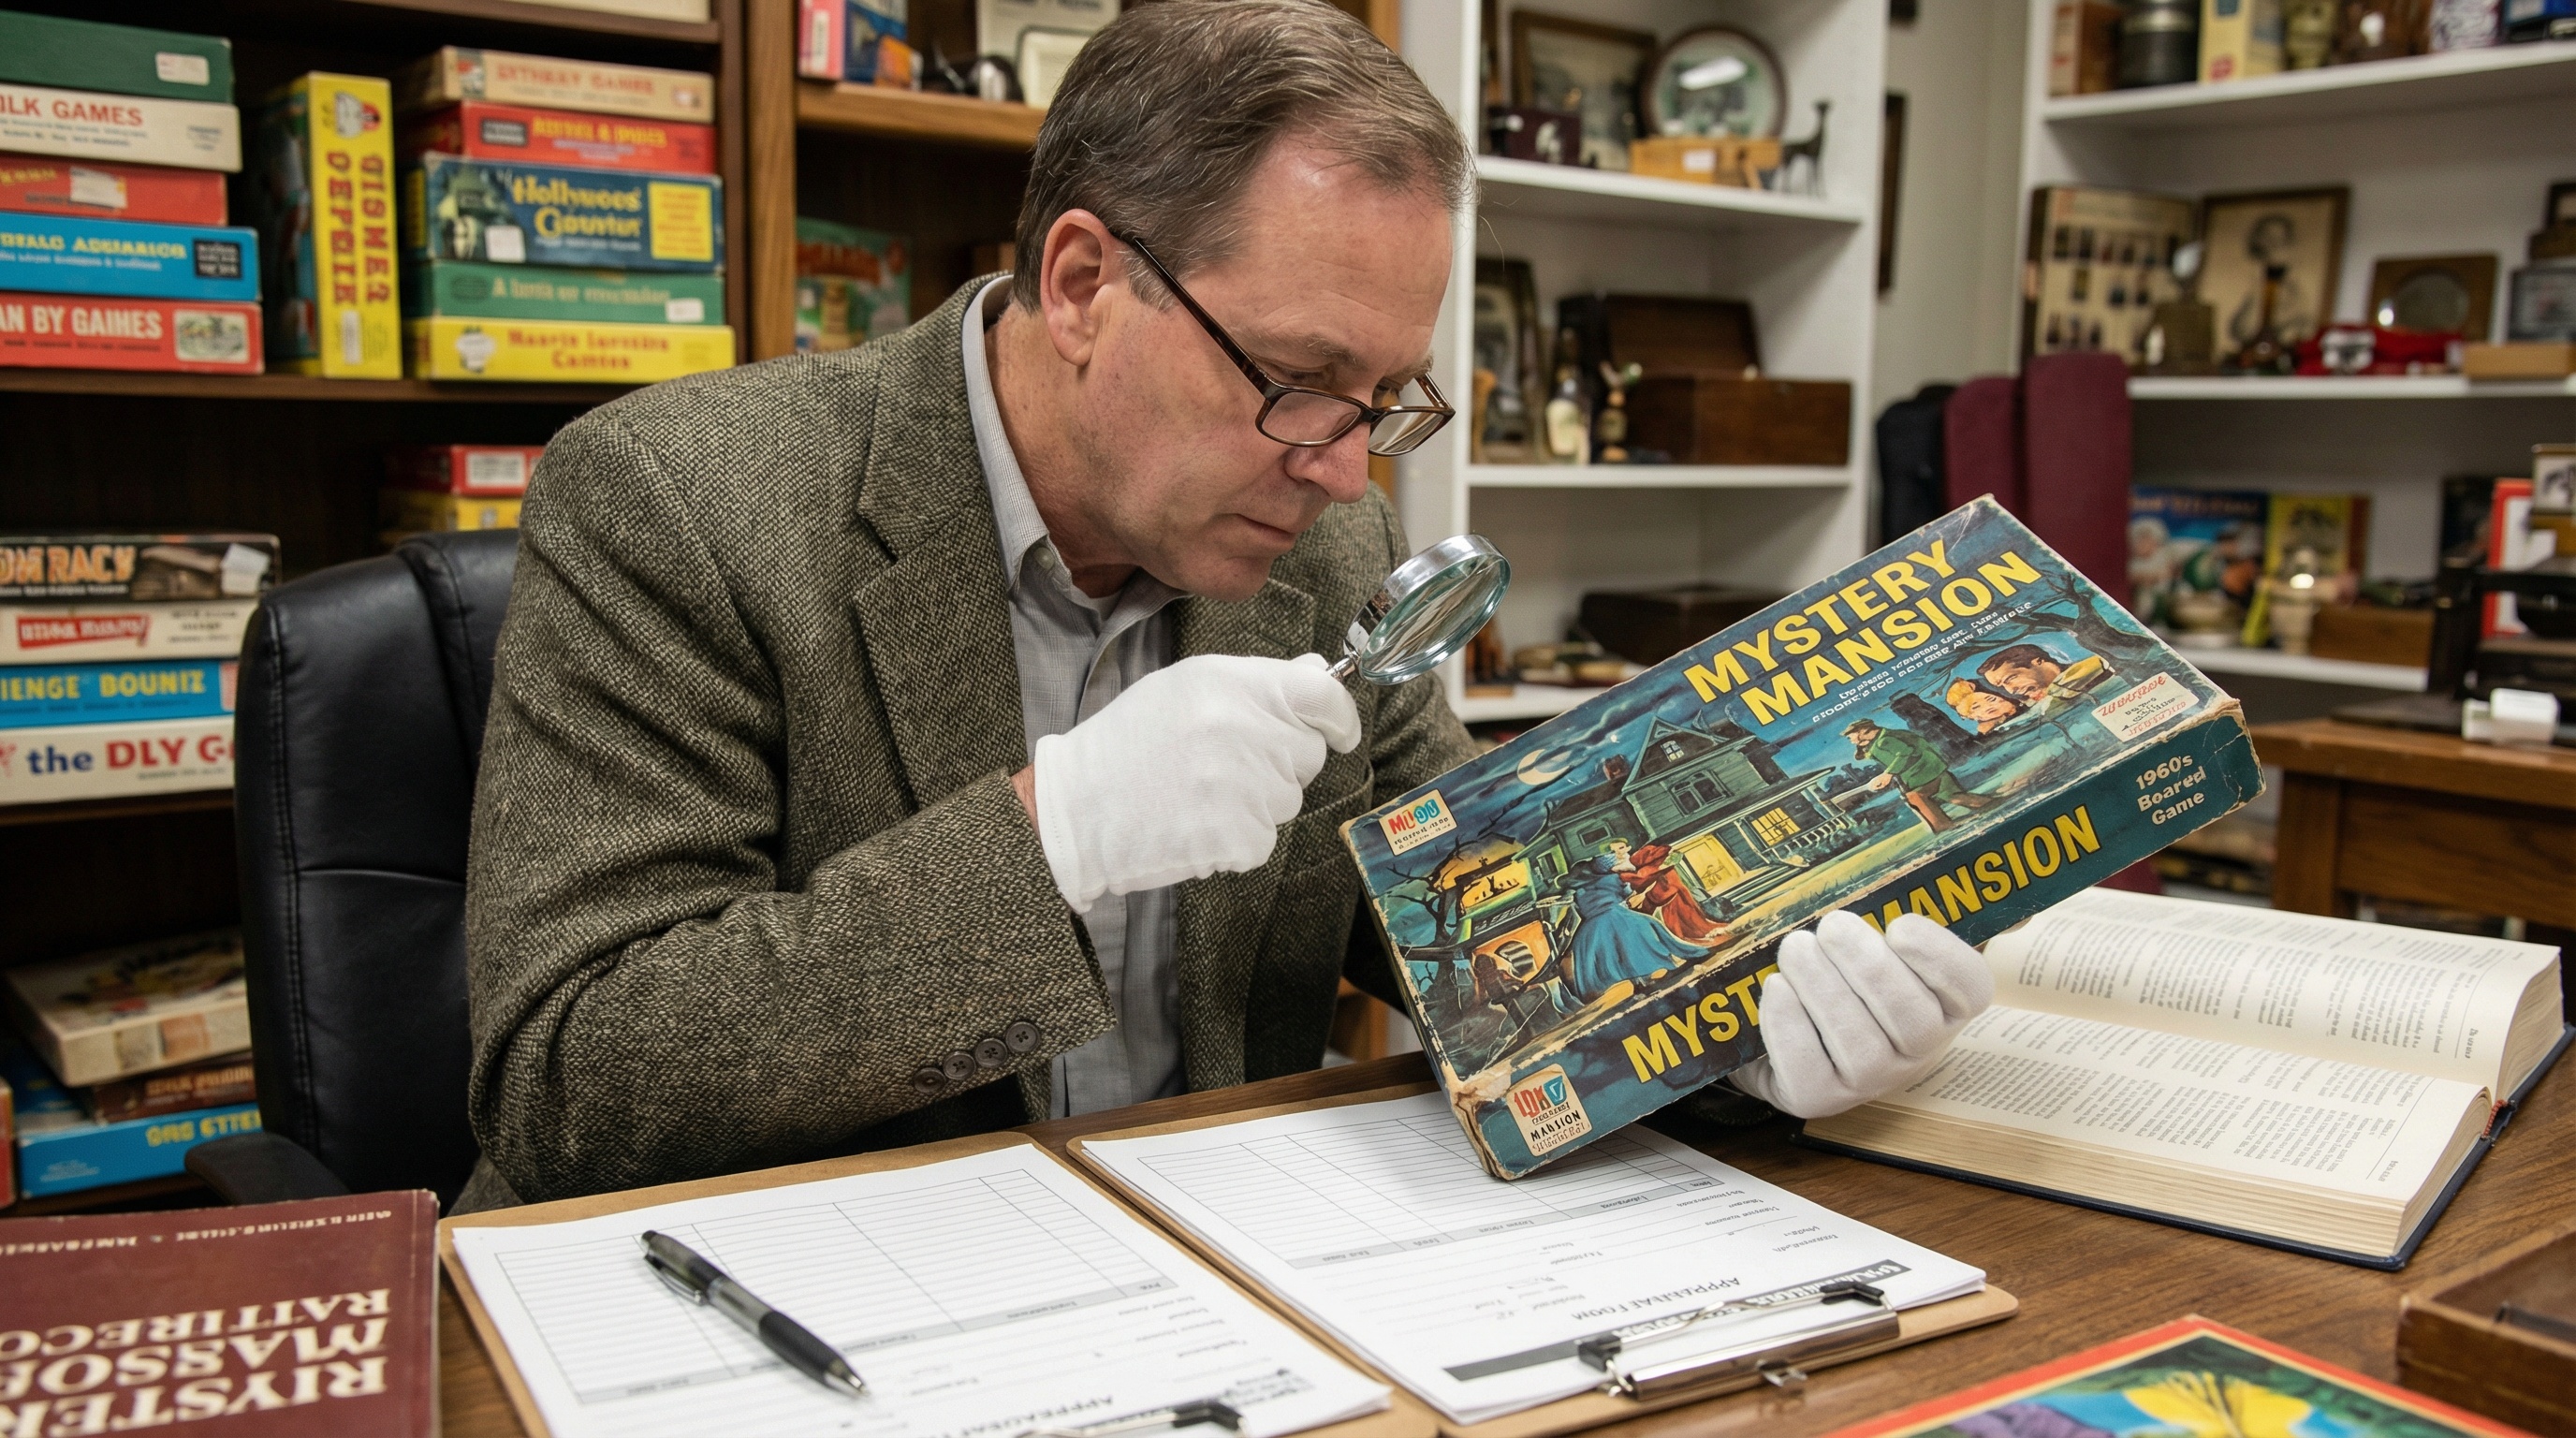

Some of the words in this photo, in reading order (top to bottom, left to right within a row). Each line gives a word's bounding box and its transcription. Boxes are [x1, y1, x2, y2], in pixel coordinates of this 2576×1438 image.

[51, 99, 143, 126] GAMES
[31, 305, 65, 335] BY
[1684, 538, 1957, 704] MYSTERY
[1740, 550, 2043, 726] MANSION
[27, 745, 93, 775] the
[106, 737, 185, 770] DLY
[2135, 754, 2194, 790] 1960's
[2137, 766, 2207, 813] Boared
[2151, 793, 2205, 826] Game
[1621, 961, 1781, 1084] MYST
